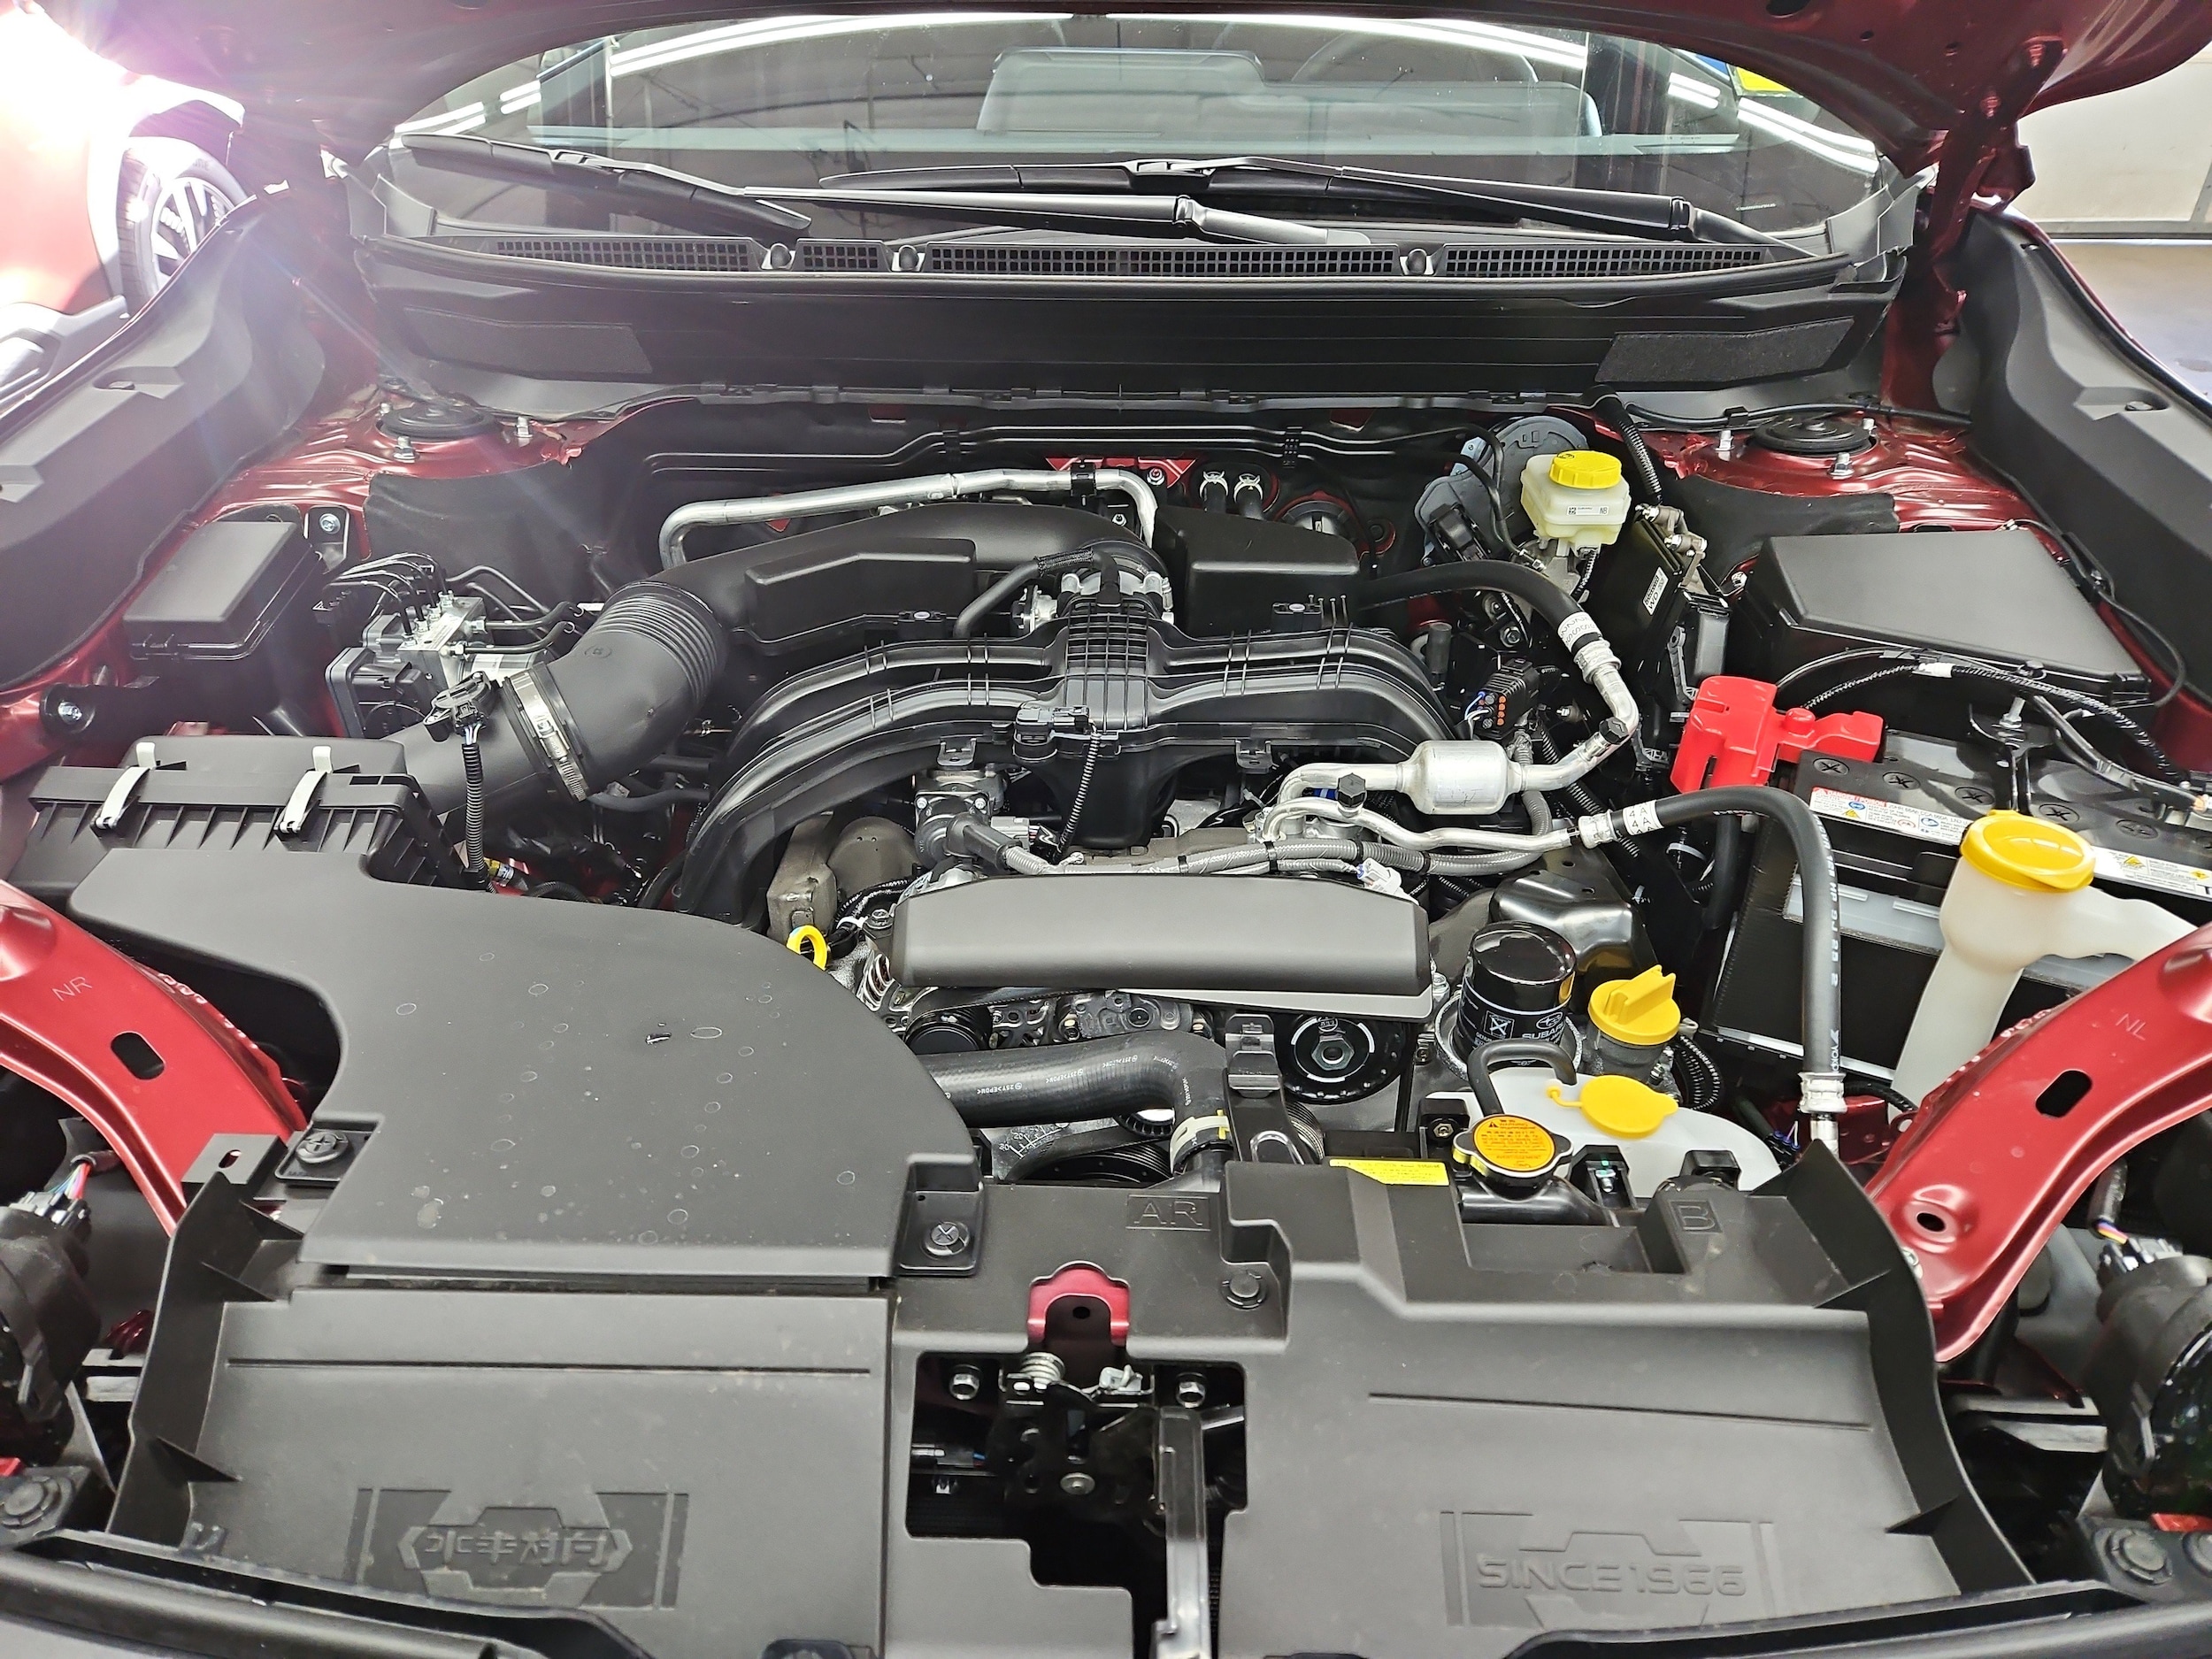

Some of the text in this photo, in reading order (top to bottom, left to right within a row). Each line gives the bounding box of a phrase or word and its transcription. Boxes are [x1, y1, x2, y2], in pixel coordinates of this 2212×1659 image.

[52, 976, 92, 1002] NR
[2116, 1013, 2146, 1041] NL
[1135, 1200, 1203, 1228] AR
[1678, 1202, 1717, 1231] B
